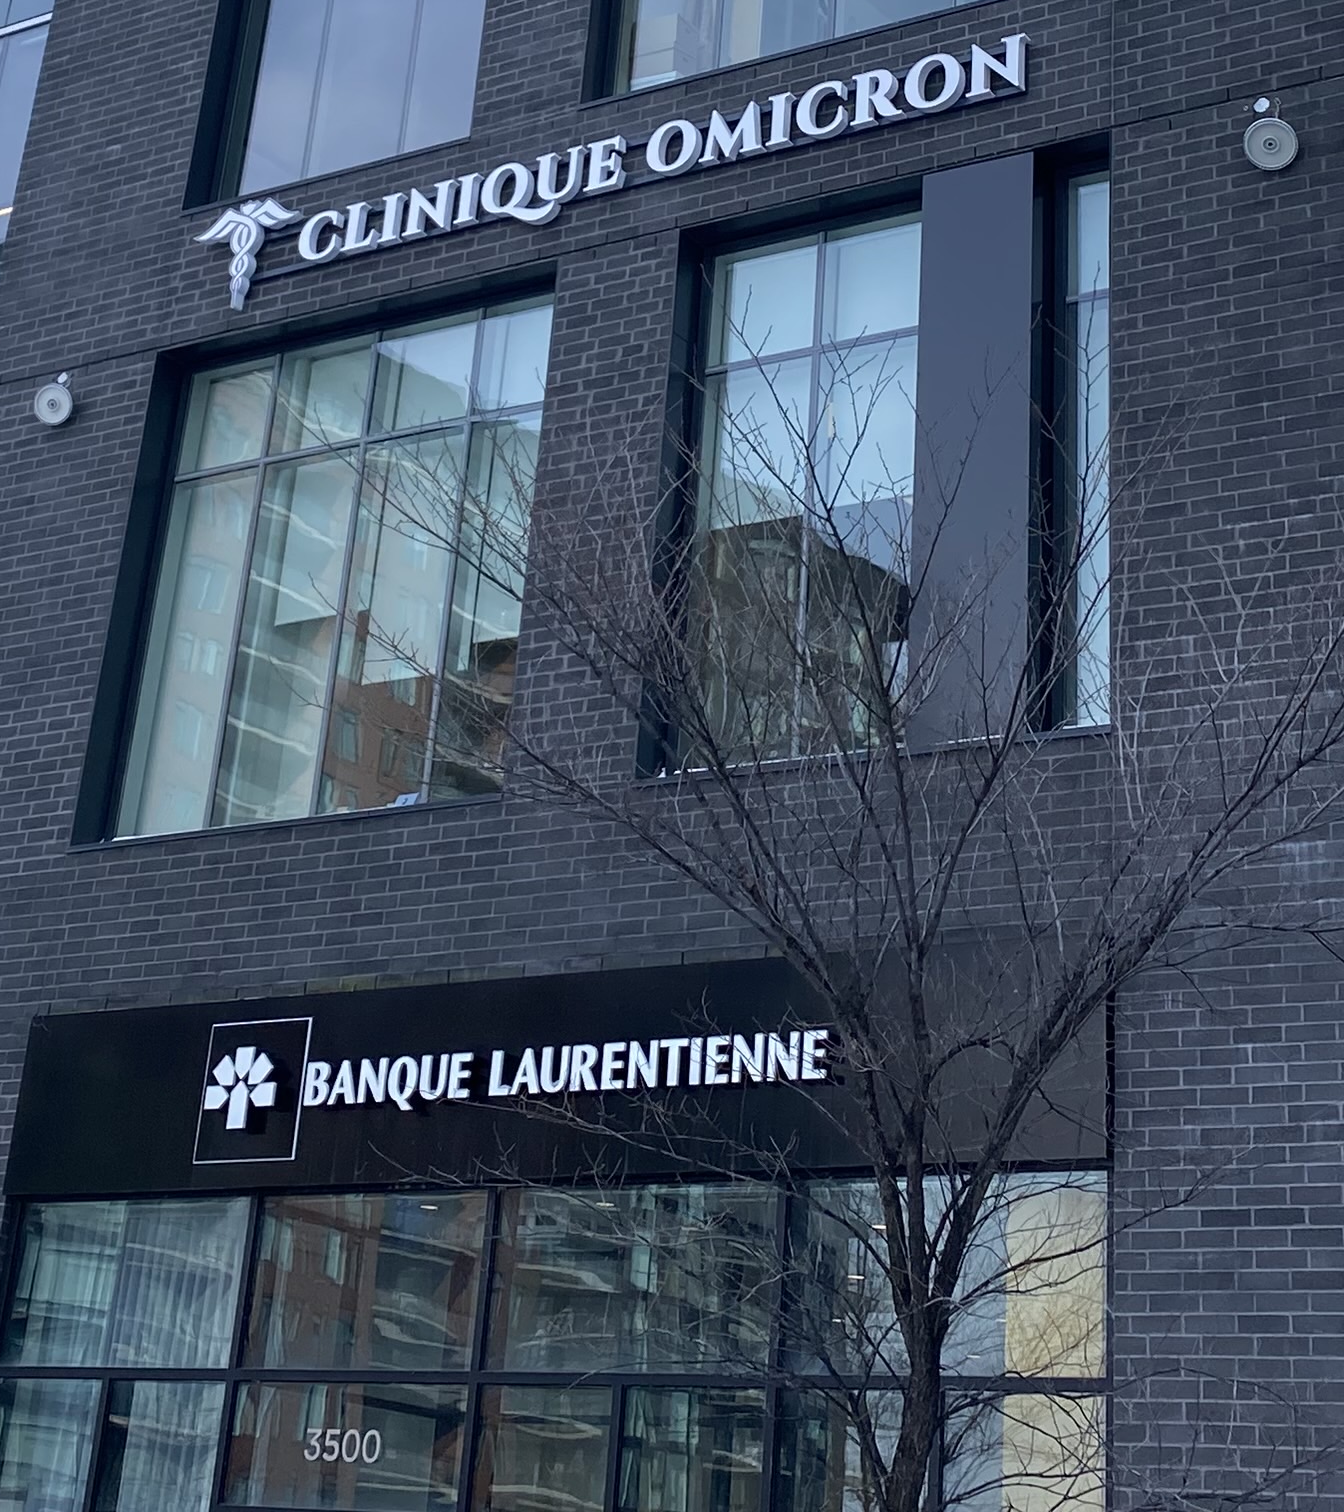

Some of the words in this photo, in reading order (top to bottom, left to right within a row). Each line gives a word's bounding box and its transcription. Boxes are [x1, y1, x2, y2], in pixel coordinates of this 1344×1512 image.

[298, 135, 627, 262] CLINIQUE
[646, 32, 1031, 176] OMICRON
[303, 1055, 474, 1111] BANQUE
[488, 1029, 829, 1096] LAURENTIENNE
[303, 1428, 381, 1464] 3500
